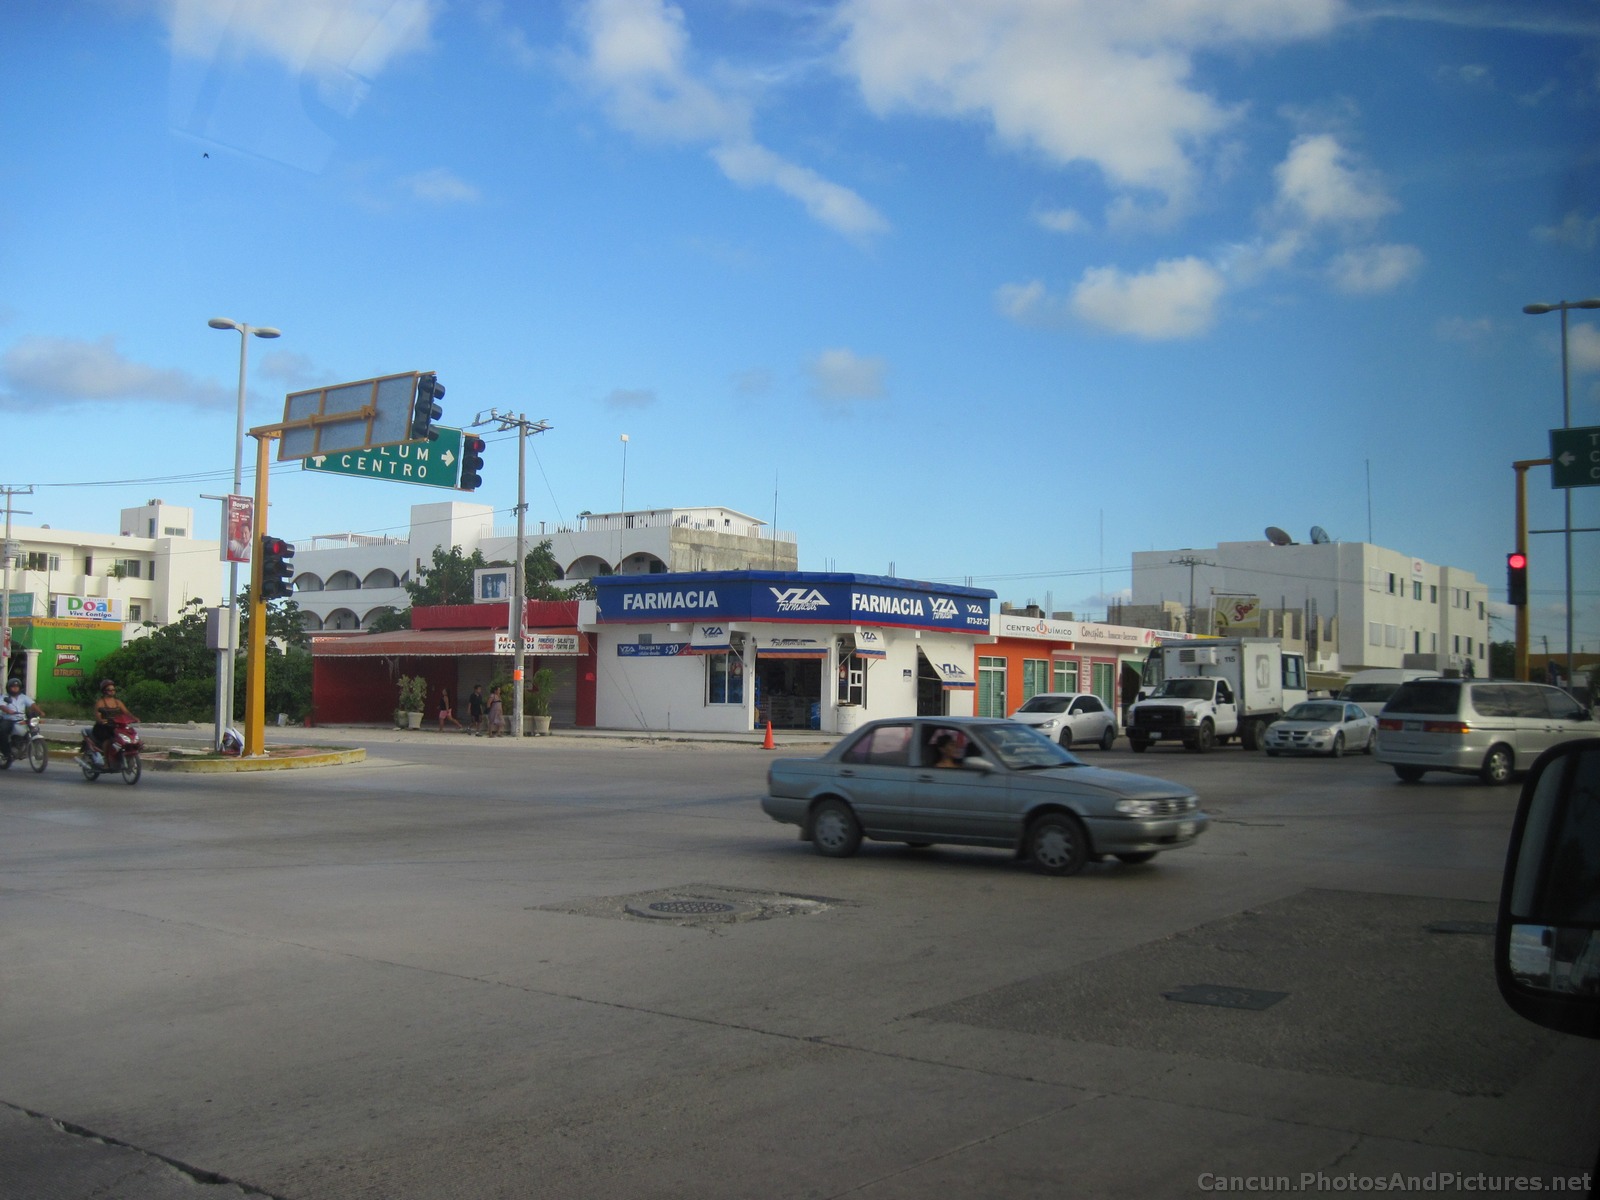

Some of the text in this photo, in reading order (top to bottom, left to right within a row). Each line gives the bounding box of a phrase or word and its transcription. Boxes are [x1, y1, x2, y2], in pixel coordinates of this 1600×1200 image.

[363, 445, 429, 461] LUM
[341, 454, 427, 478] CENTRO
[623, 590, 719, 610] FARMACIA
[769, 587, 830, 605] YZA
[851, 593, 959, 616] FARMACIA YZA
[966, 604, 983, 614] YZA
[702, 627, 724, 635] YZA
[1006, 624, 1036, 633] CENTRO
[665, 644, 679, 655] $20
